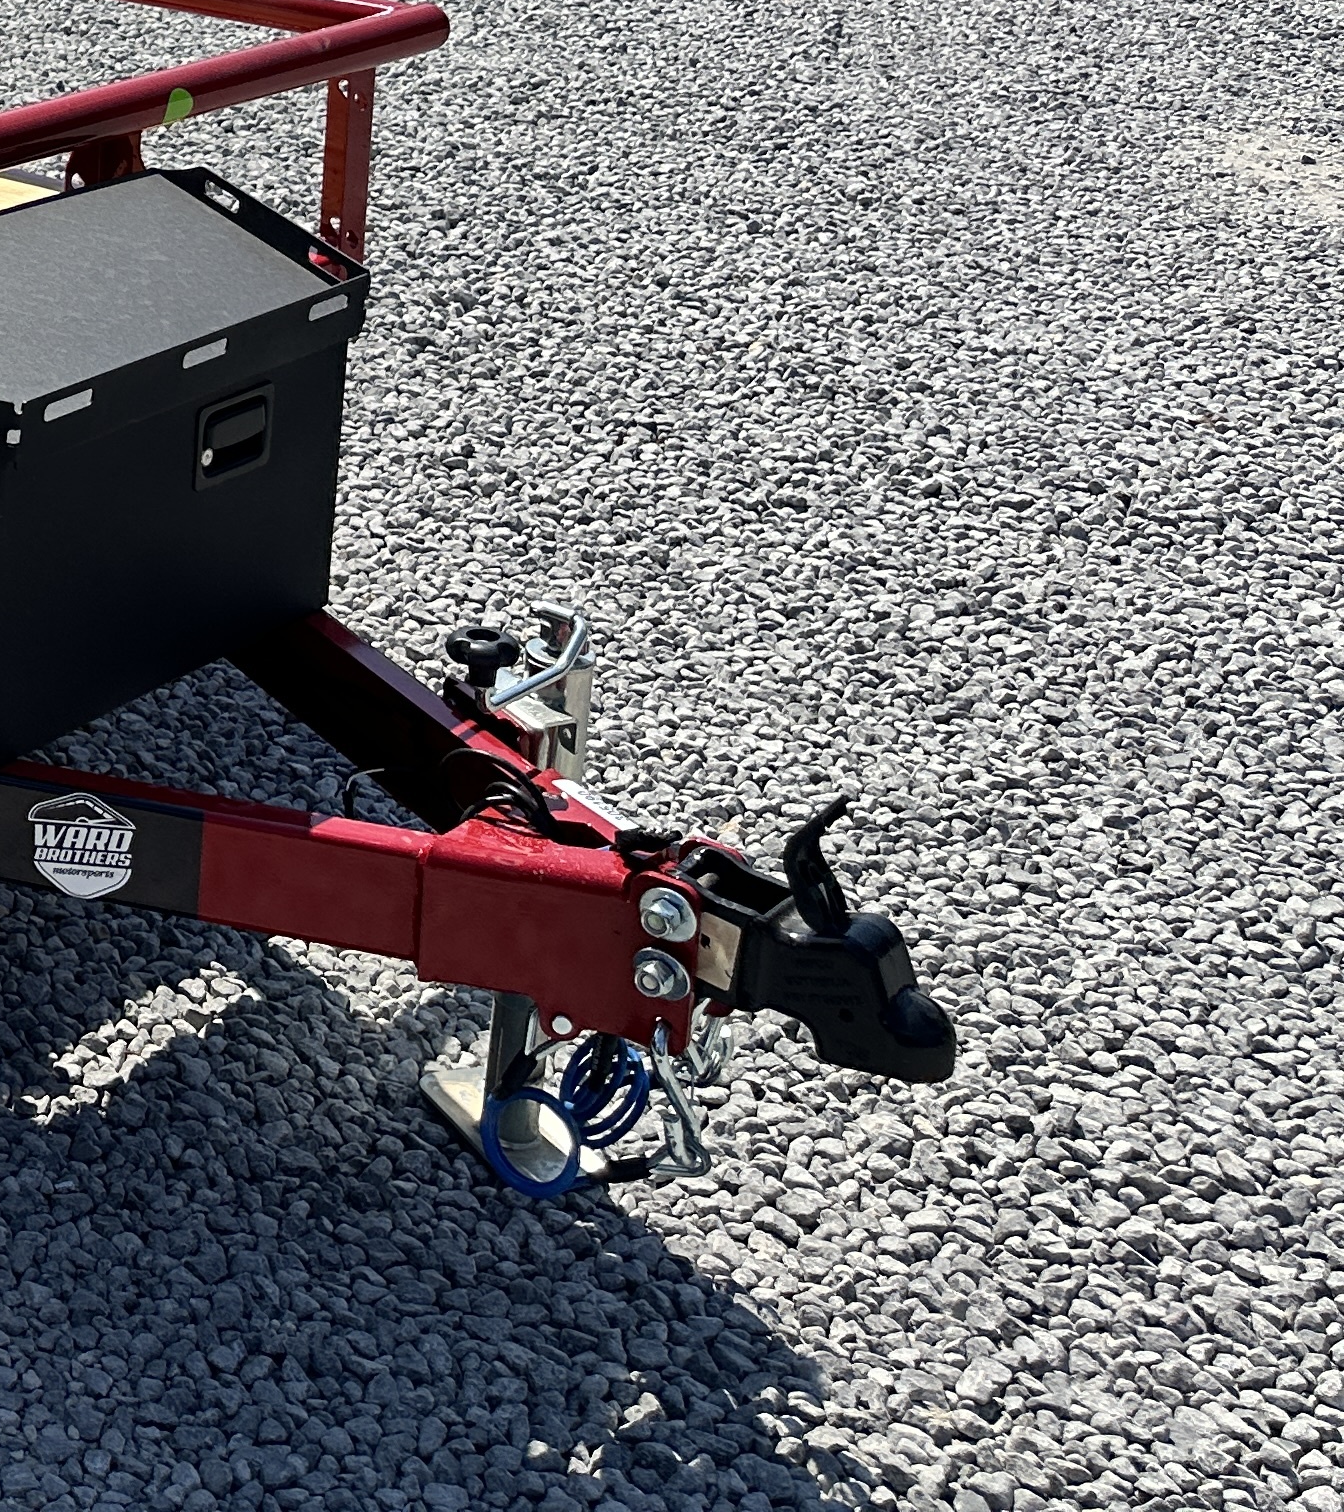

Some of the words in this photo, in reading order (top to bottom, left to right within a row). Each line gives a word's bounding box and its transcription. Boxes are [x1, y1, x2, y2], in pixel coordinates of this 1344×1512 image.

[34, 823, 133, 853] WARD
[33, 847, 132, 867] BROTHERS
[52, 867, 115, 880] motorsports
